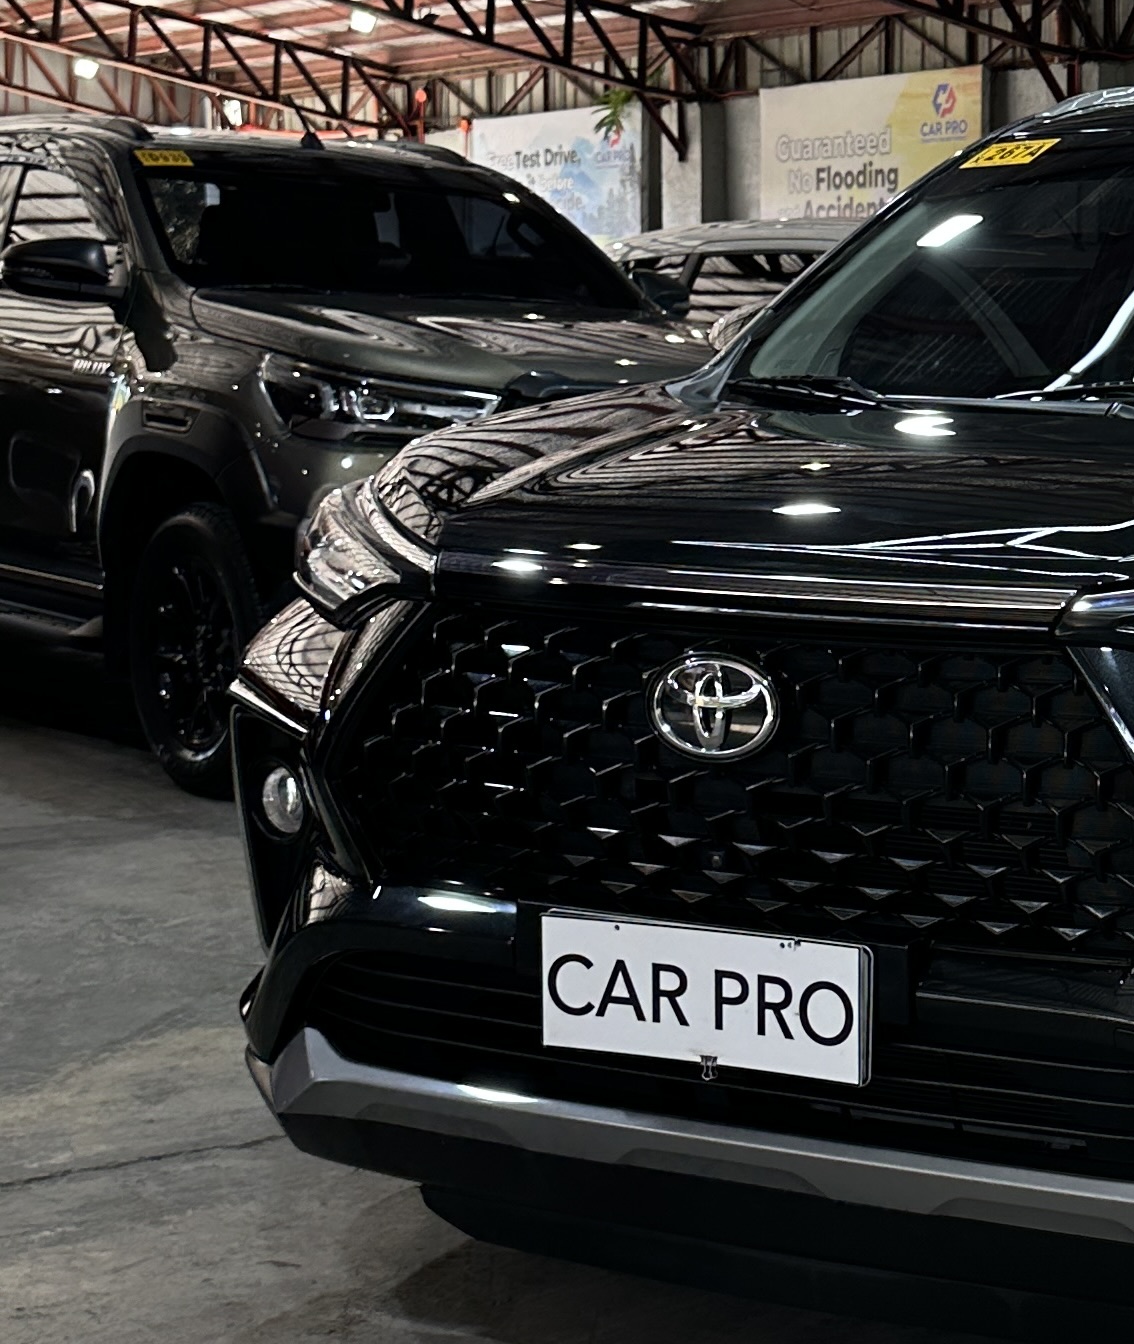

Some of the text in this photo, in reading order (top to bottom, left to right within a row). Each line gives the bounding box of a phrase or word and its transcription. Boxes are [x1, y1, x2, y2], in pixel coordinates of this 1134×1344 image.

[776, 125, 893, 162] Guaranteed
[920, 119, 968, 137] CAR PRO
[515, 150, 541, 169] Test
[816, 160, 898, 193] Flooding
[547, 953, 855, 1047] CAR PRO
